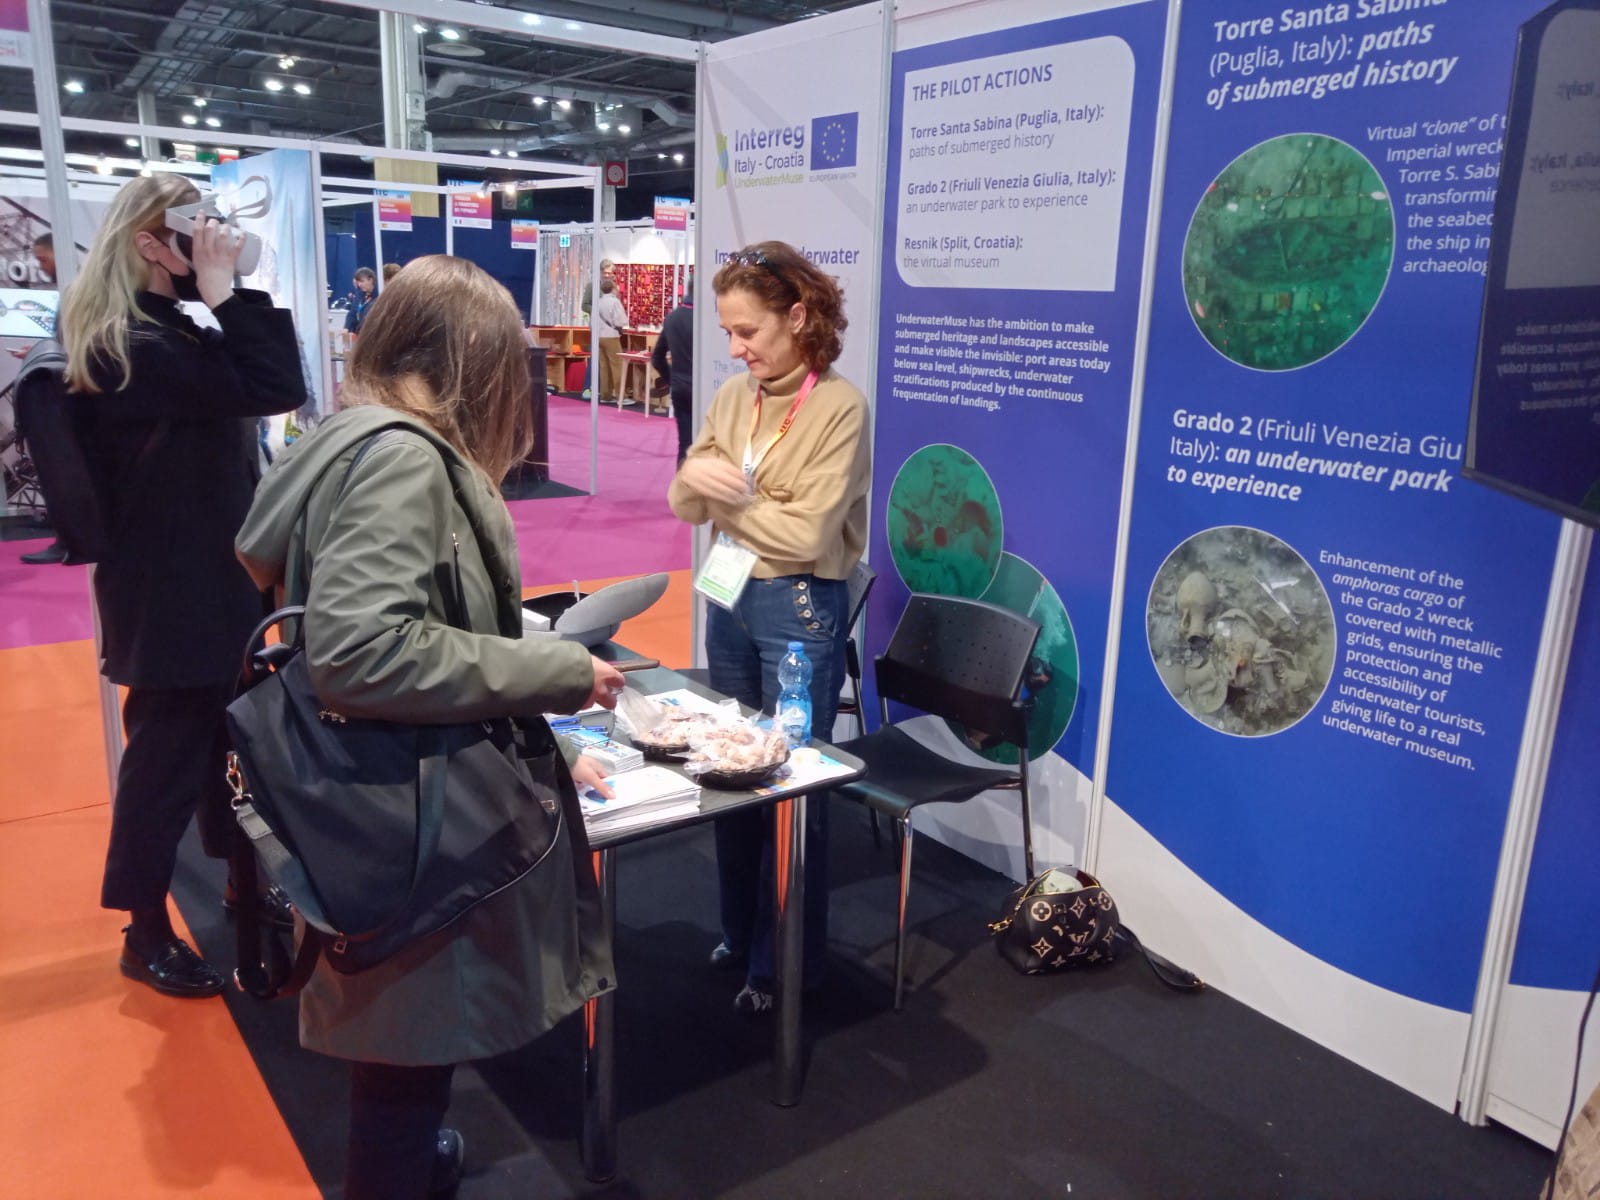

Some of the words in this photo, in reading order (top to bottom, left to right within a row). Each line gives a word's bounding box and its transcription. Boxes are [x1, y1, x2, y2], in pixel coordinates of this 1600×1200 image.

[1214, 16, 1274, 42] Torre
[1279, 3, 1349, 32] Santa
[1356, 0, 1448, 19] Sab
[1210, 45, 1284, 78] (Puglia,
[1291, 34, 1354, 64] Italy):
[1357, 20, 1435, 60] paths
[912, 83, 937, 102] THE
[940, 75, 981, 98] PILOT
[984, 64, 1053, 91] ACTIONS
[1206, 81, 1231, 110] of
[1231, 64, 1360, 99] submerged
[1362, 56, 1459, 87] history
[910, 123, 938, 140] Torre
[939, 120, 970, 137] Santa
[973, 115, 1012, 132] Sabina
[1015, 109, 1061, 130] (Puglia,
[1065, 103, 1105, 124] Italy):
[1367, 122, 1417, 141] Virtual
[1478, 113, 1499, 132] of
[735, 125, 805, 152] Interreg
[909, 144, 936, 160] paths
[938, 142, 949, 156] of
[950, 136, 1011, 155] submerged
[1014, 132, 1055, 150] history
[1386, 142, 1453, 164] Imperial
[1455, 138, 1504, 157] wreck
[734, 157, 757, 175] Italy
[765, 151, 804, 170] Croatia
[1399, 168, 1441, 184] Torre
[1445, 165, 1459, 182] S.
[1464, 163, 1502, 180] Sabi
[907, 180, 938, 196] Grado
[940, 180, 947, 193] 2
[949, 177, 981, 194] (Friuli
[984, 174, 1030, 190] Venezia
[1033, 171, 1073, 188] Giulia,
[1077, 169, 1116, 187] Italy):
[906, 203, 918, 214] an
[920, 198, 978, 213] underwater
[981, 196, 1005, 214] park
[1008, 197, 1020, 209] to
[1022, 193, 1088, 212] experience
[1408, 212, 1434, 228] the
[904, 237, 938, 250] Resnik
[940, 236, 971, 252] (Split,
[974, 235, 1024, 251] Croatia):
[1407, 235, 1433, 250] the
[1436, 235, 1471, 253] ship
[903, 256, 919, 268] the
[920, 256, 951, 268] virtual
[954, 258, 1000, 268] museum
[895, 313, 968, 327] UnderwaterMuse
[969, 316, 985, 328] has
[987, 317, 1004, 329] the
[1004, 318, 1049, 332] ambition
[1051, 321, 1063, 332] to
[1064, 321, 1095, 334] make
[895, 329, 940, 343] submerged
[942, 330, 979, 346] heritage
[980, 333, 998, 345] and
[999, 334, 1053, 351] landscapes
[1055, 339, 1109, 352] accessible
[893, 357, 918, 370] below
[919, 361, 933, 371] sea
[934, 361, 957, 375] level,
[959, 363, 1012, 380] shipwrecks,
[1014, 369, 1074, 384] underwater
[894, 343, 910, 354] and
[911, 344, 934, 356] make
[935, 346, 964, 358] visible
[964, 348, 980, 360] the
[981, 349, 1024, 363] invisible:
[1024, 354, 1047, 367] port
[1048, 356, 1078, 368] areas
[1079, 357, 1111, 373] today
[892, 387, 949, 404] frequentation
[950, 394, 960, 405] of
[960, 395, 1001, 412] landings.
[893, 374, 950, 388] stratifications
[951, 380, 993, 393] produced
[994, 383, 1006, 397] by
[1008, 384, 1025, 396] the
[1026, 388, 1084, 403] continuous
[1172, 408, 1235, 434] Grado
[1239, 416, 1253, 436] 2
[1256, 418, 1317, 444] (Friuli
[1322, 424, 1411, 455] Venezia
[1419, 435, 1463, 461] Giu
[1170, 436, 1220, 463] Italy):
[1225, 447, 1250, 465] an
[1256, 450, 1388, 483] underwater
[1389, 468, 1453, 492] park
[1167, 465, 1187, 483] to
[1191, 470, 1302, 501] experience
[1319, 549, 1415, 581] Enhancement
[1418, 570, 1436, 584] of
[1438, 573, 1464, 590] the
[1332, 573, 1401, 597] amphoras
[1403, 587, 1444, 607] cargo
[1447, 595, 1466, 609] of
[1340, 591, 1364, 607] the
[1367, 597, 1411, 618] Grado
[1414, 607, 1424, 621] 2
[1428, 612, 1474, 632] wreck
[1345, 612, 1401, 634] covered
[1404, 626, 1437, 643] with
[1440, 634, 1502, 659] metallic
[1345, 649, 1419, 677] protection
[1422, 670, 1452, 685] and
[1346, 631, 1384, 650] grids,
[1388, 640, 1453, 670] ensuring
[1456, 657, 1483, 674] the
[1343, 666, 1427, 700] accessibility
[1430, 690, 1448, 703] of
[1331, 699, 1372, 723] giving
[1374, 710, 1396, 727] life
[1400, 718, 1415, 733] to
[1417, 725, 1427, 736] a
[1431, 728, 1461, 746] real
[1339, 683, 1422, 715] underwater
[1424, 706, 1486, 736] tourists,
[1322, 714, 1403, 747] underwater
[1405, 739, 1476, 771] museum.
